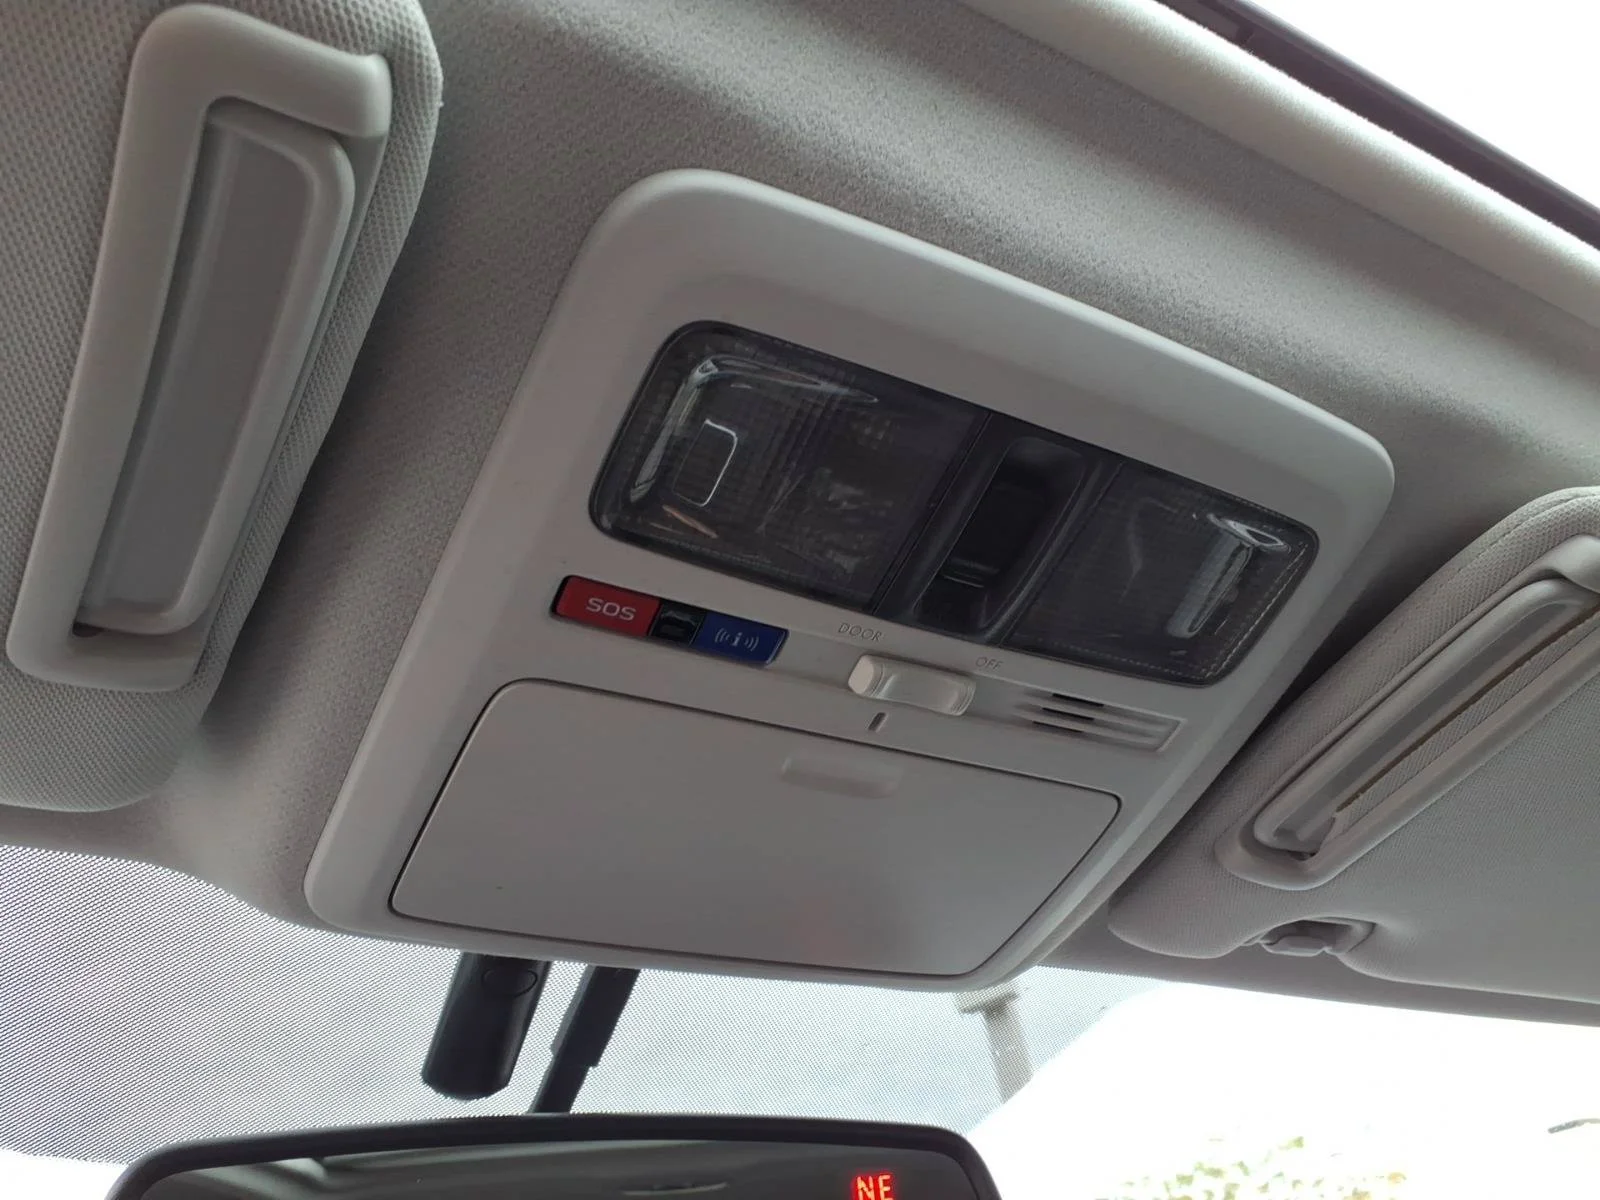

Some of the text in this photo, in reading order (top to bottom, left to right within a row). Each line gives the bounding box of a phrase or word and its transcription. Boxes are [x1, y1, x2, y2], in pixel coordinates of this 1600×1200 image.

[586, 597, 636, 621] SOS
[838, 623, 883, 642] DOOR
[975, 656, 1002, 671] OFF
[856, 1174, 893, 1200] NE
